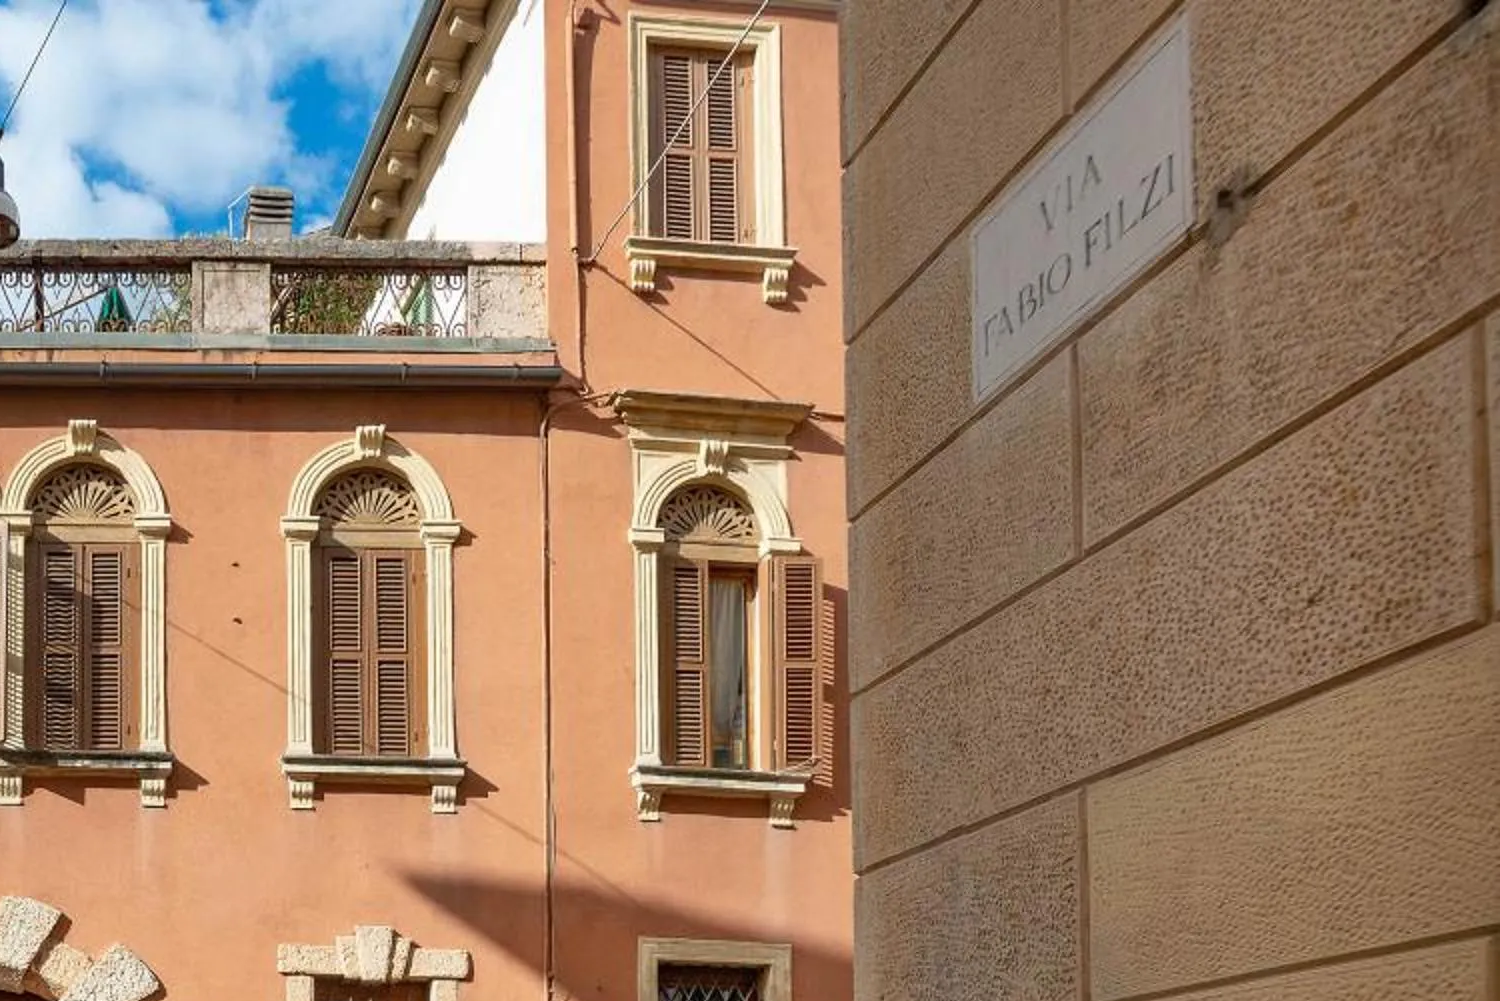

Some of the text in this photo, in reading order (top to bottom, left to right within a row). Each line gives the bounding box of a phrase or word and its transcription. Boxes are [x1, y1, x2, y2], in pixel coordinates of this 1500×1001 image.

[983, 154, 1174, 357] FABIO FILZI
[1040, 155, 1102, 231] VIA
